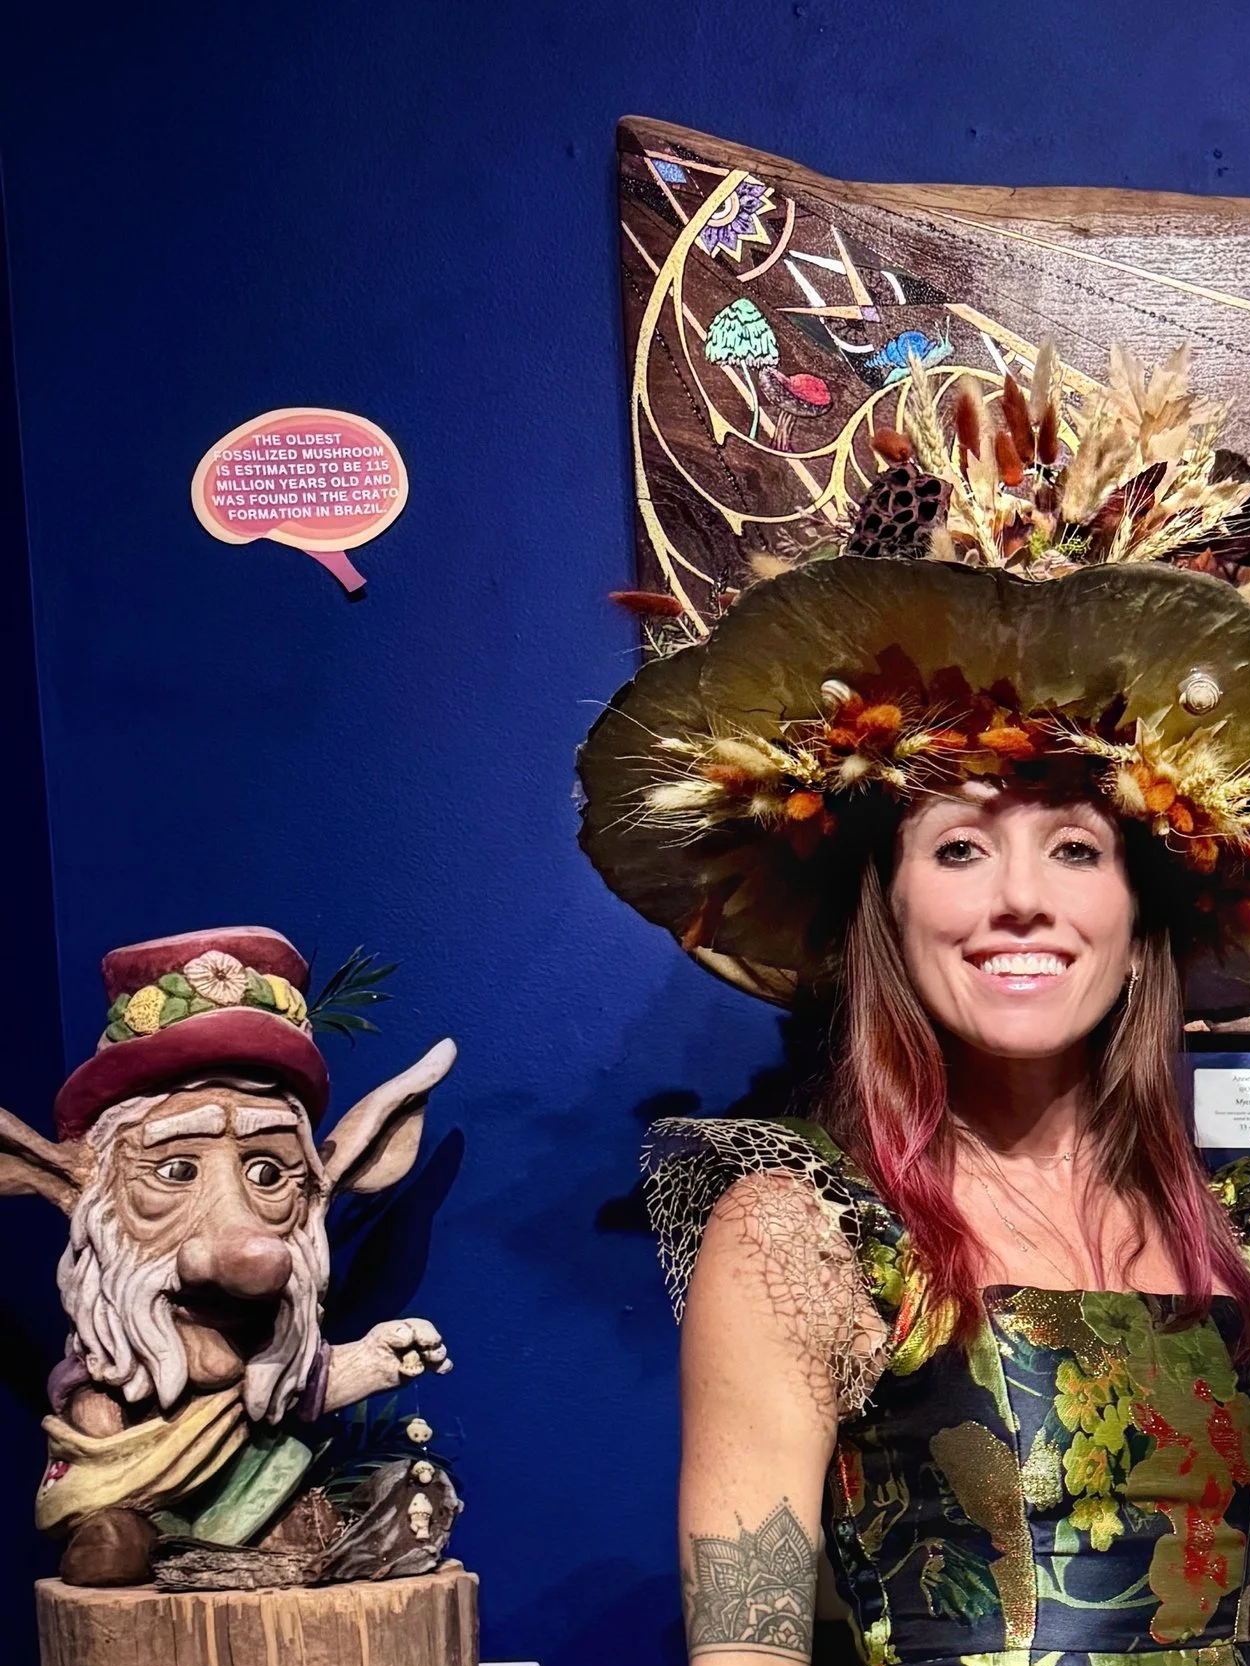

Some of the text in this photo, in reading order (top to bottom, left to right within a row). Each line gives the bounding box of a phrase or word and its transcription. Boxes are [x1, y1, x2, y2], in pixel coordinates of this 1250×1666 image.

[252, 433, 342, 446] THE OLDEST
[213, 446, 384, 461] FOSSILIZED MUSHROOM
[216, 461, 389, 476] IS ESTIMATED TO BE 115
[216, 474, 392, 491] MILLION YEARS OLD AND
[212, 487, 398, 506] WAS FOUND IN THE CRATO
[228, 503, 387, 520] FORMATION IN BRAZIL.
